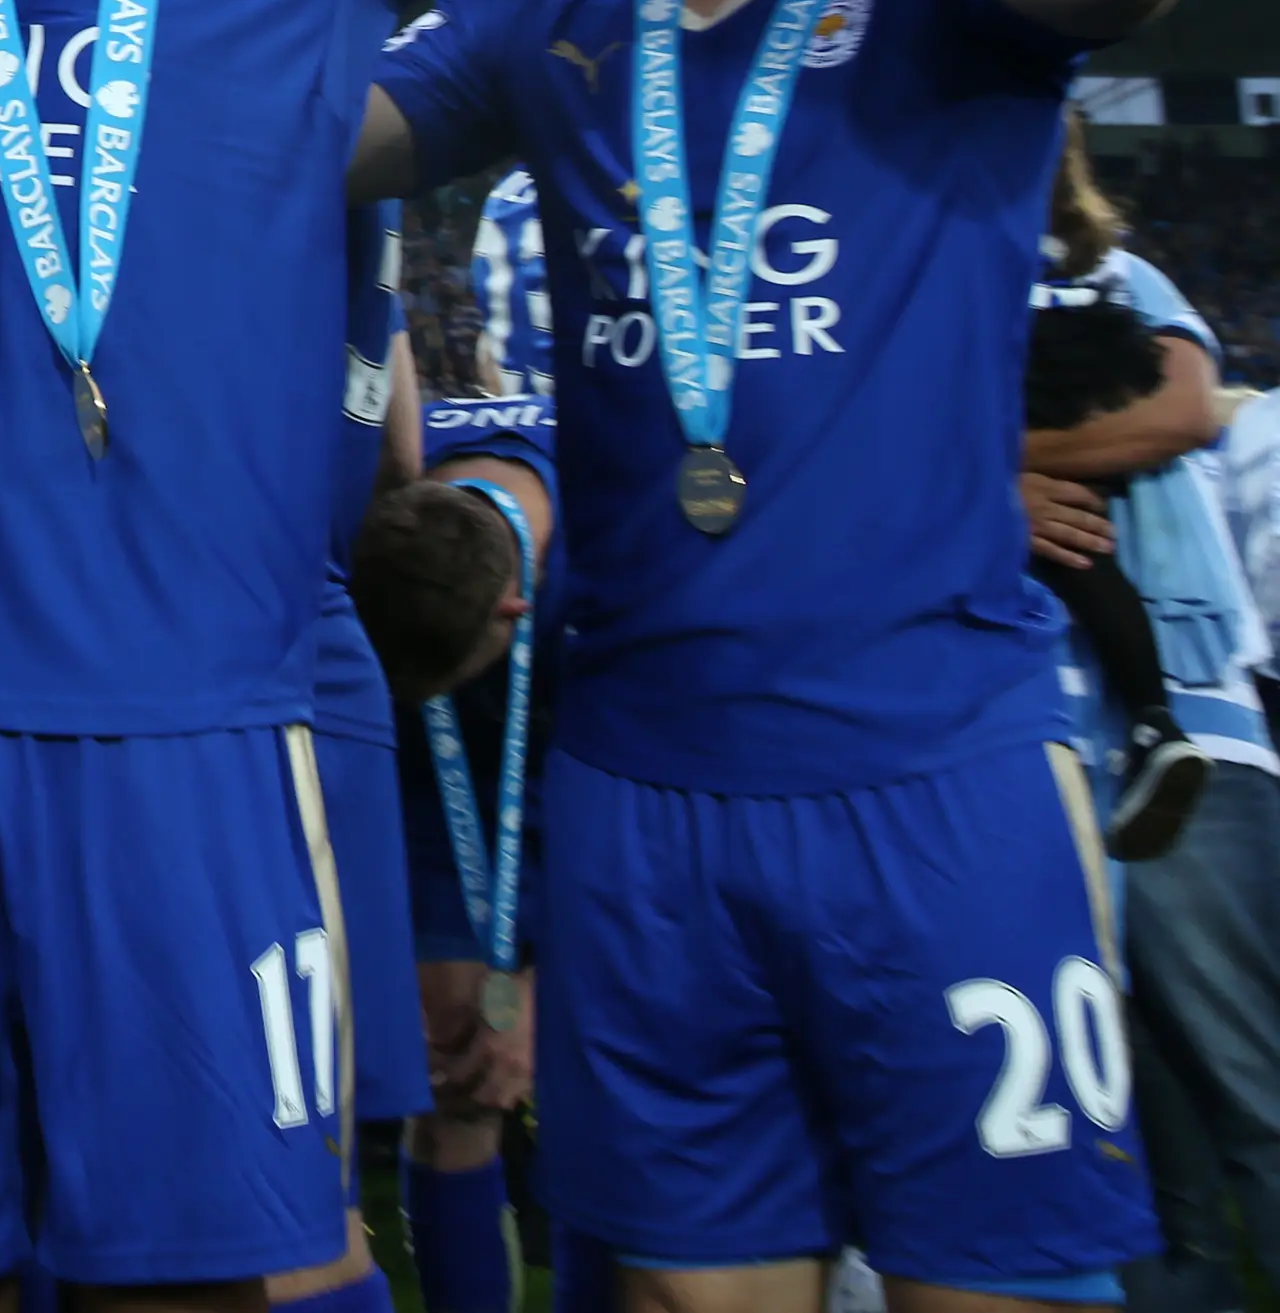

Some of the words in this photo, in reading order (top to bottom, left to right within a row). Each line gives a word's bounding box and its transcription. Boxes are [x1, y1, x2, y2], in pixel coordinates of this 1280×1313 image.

[89, 123, 132, 312] BARCLAYS
[573, 203, 840, 301] KIG
[582, 296, 846, 368] POER
[250, 927, 335, 1130] 11
[943, 954, 1132, 1159] 20
